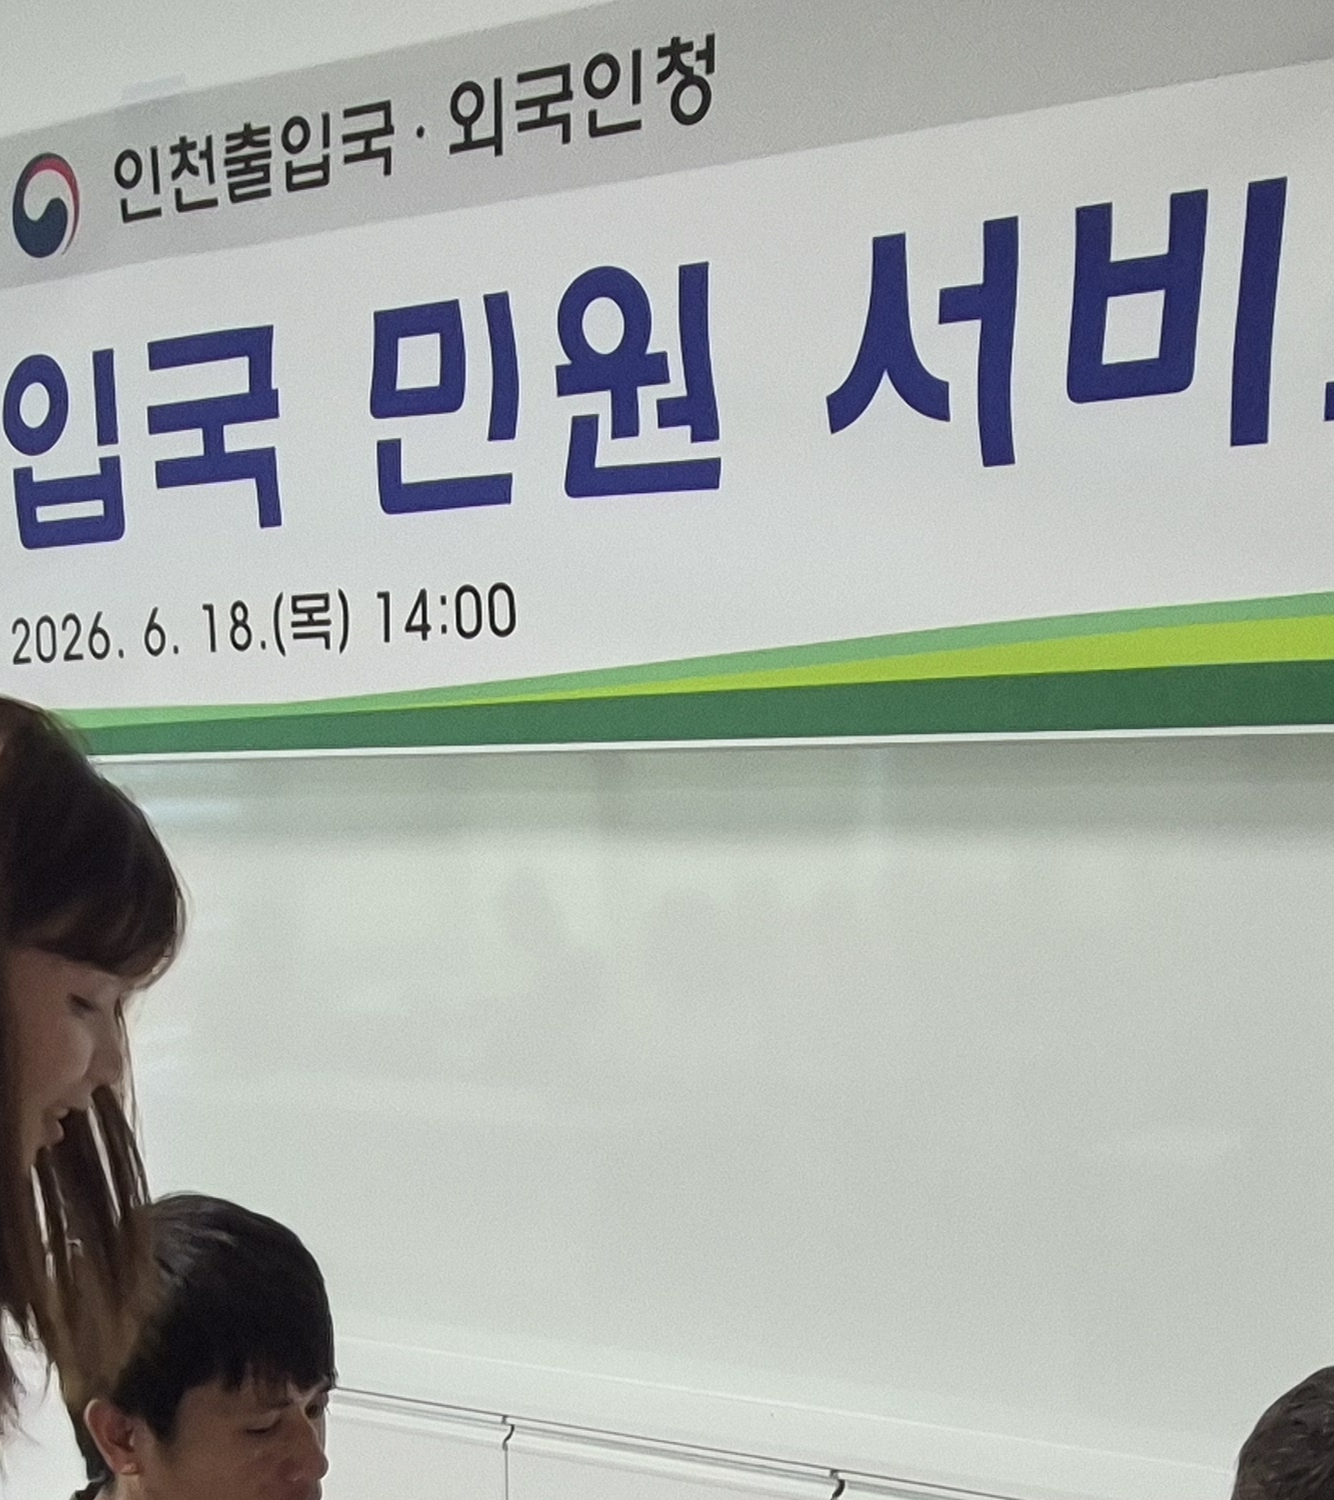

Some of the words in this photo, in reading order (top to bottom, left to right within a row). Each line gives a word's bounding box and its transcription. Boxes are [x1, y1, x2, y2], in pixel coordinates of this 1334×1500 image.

[113, 99, 395, 224] 인천출입국
[449, 32, 716, 158] 외국인청
[369, 261, 722, 515] 민원
[11, 611, 124, 666] 2026.
[144, 606, 179, 657] 6.
[202, 588, 349, 657] 18.(목)
[376, 582, 517, 643] 14:00
